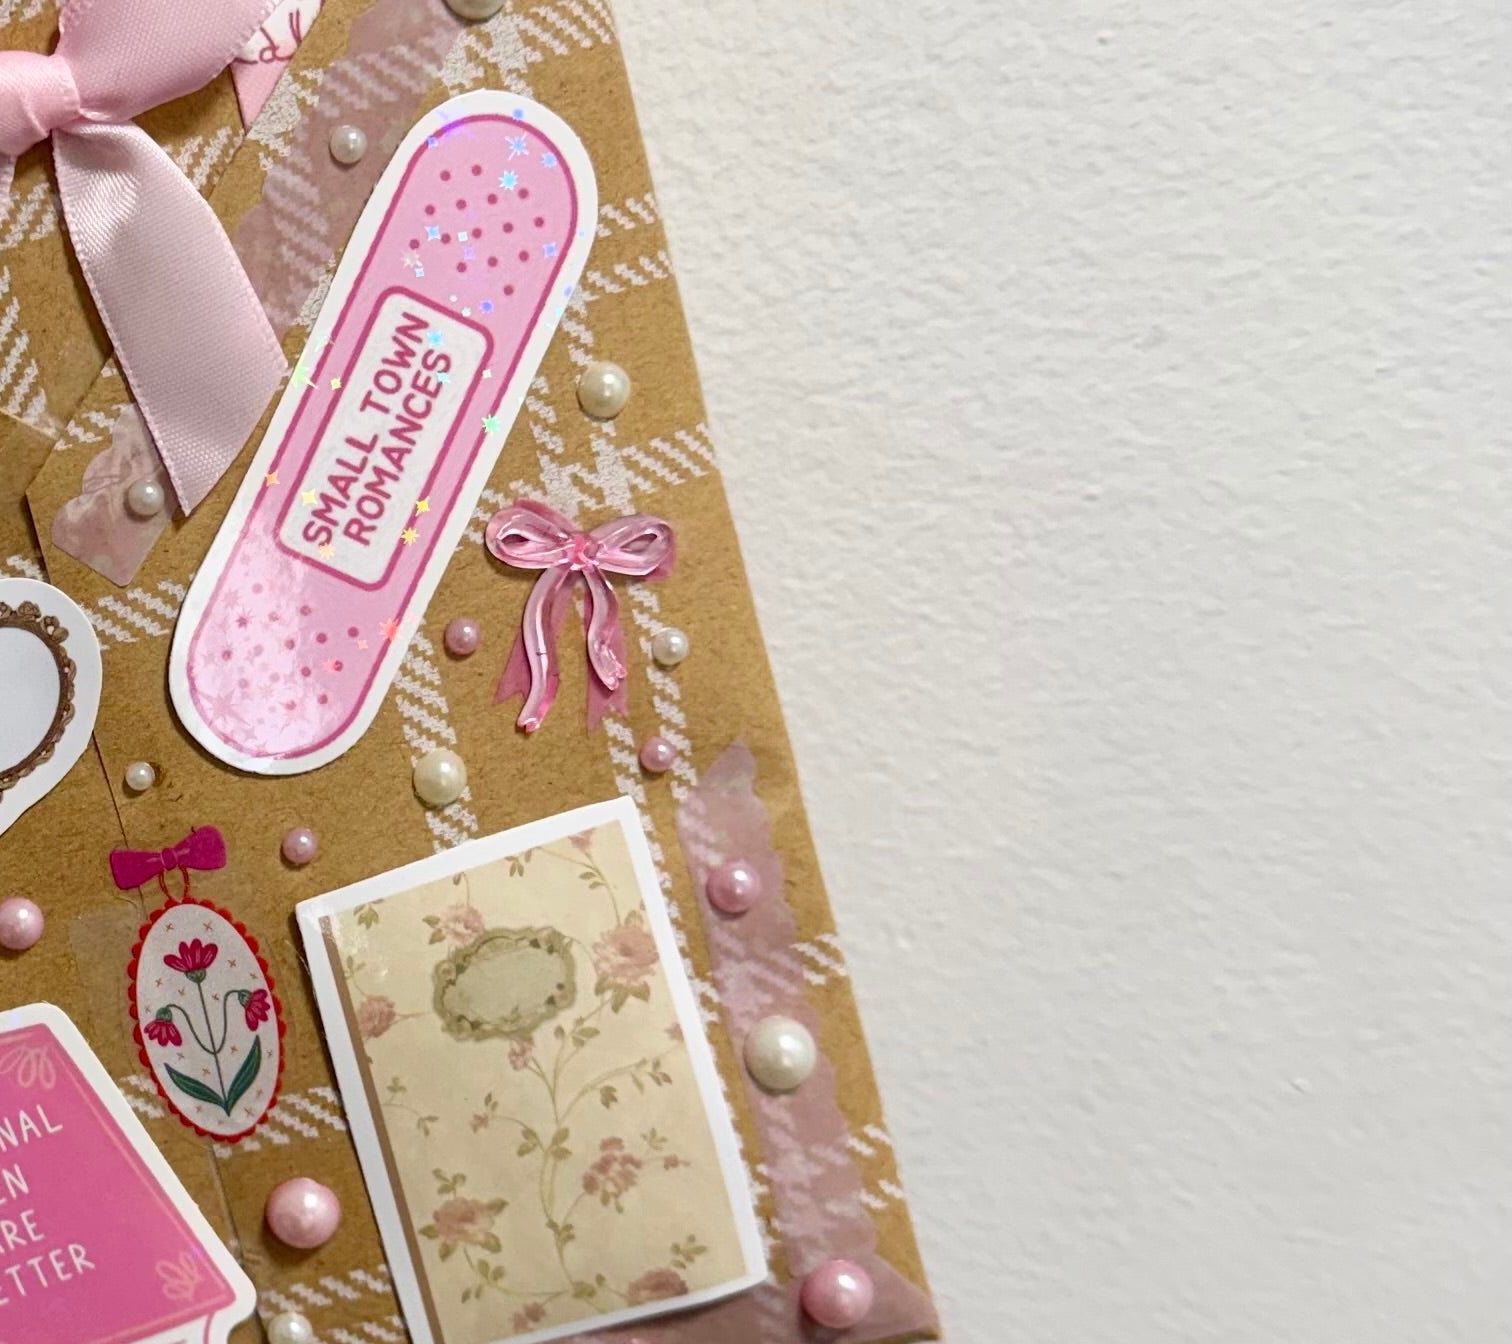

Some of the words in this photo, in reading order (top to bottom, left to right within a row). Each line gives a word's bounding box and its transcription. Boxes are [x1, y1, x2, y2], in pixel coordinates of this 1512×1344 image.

[302, 432, 378, 545] SMALL
[358, 311, 431, 422] TOWN
[343, 348, 453, 548] ROMANCES
